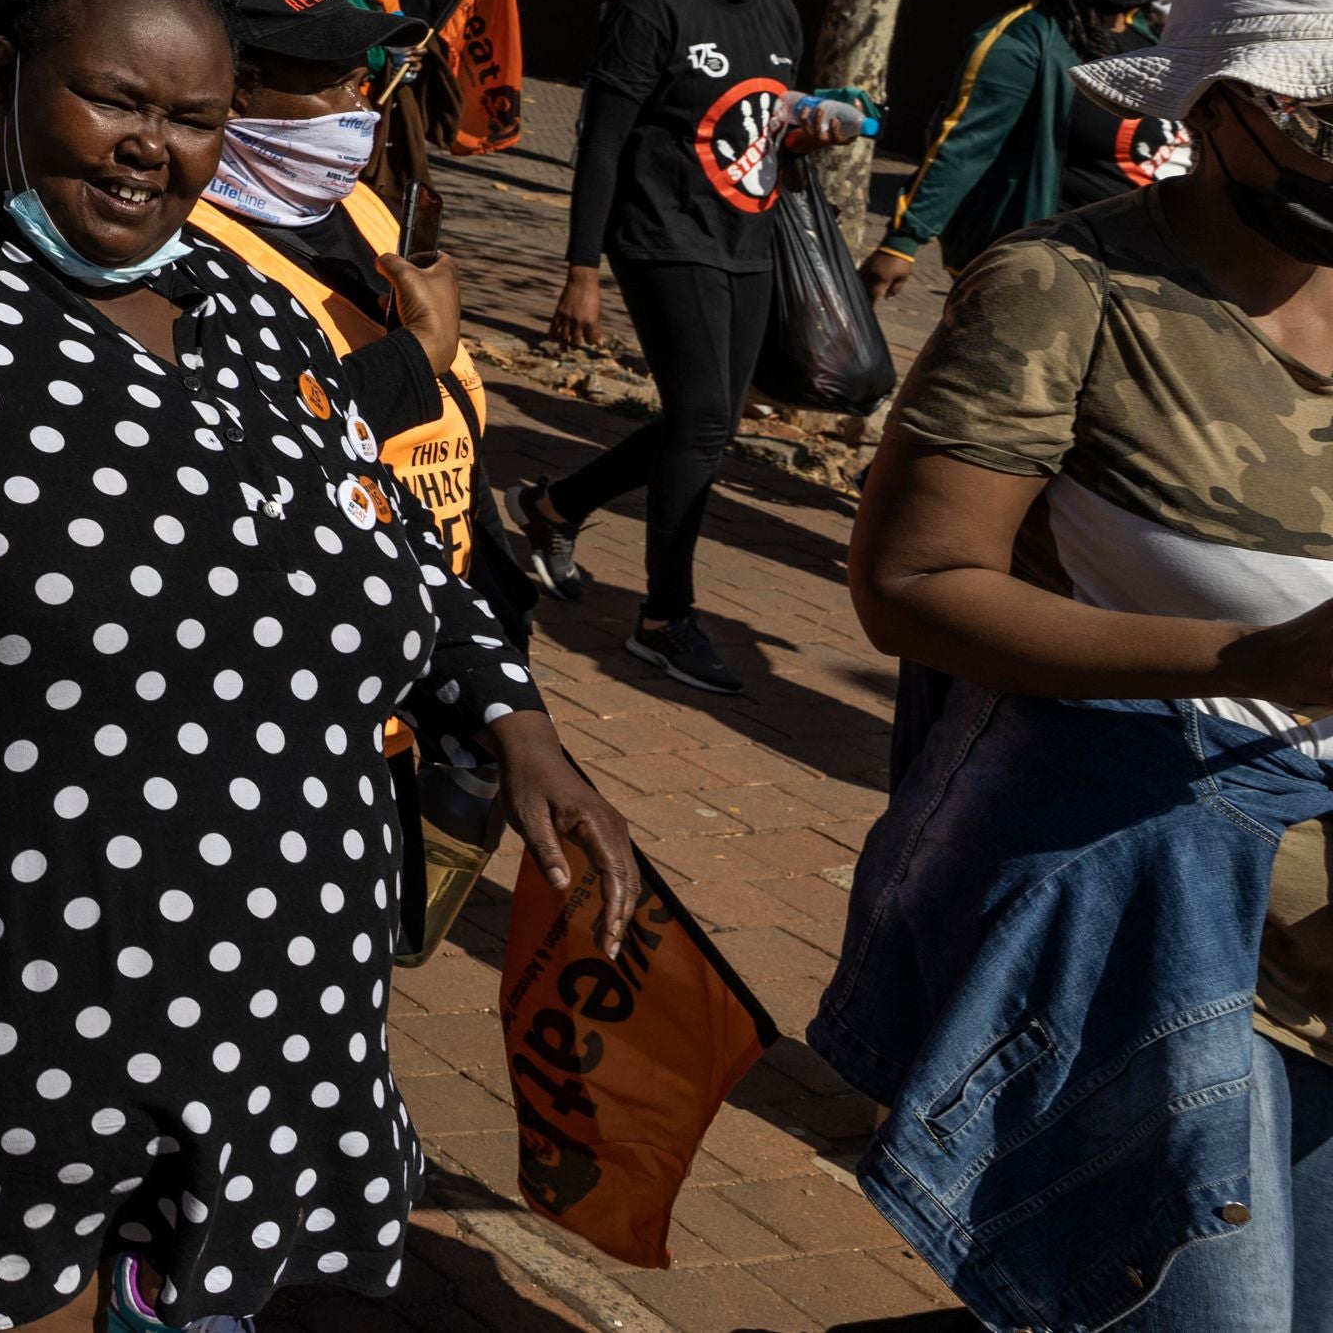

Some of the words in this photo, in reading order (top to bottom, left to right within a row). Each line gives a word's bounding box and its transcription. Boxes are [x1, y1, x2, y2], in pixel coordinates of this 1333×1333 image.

[209, 177, 267, 210] LifeLine
[411, 440, 450, 467] THIS
[455, 436, 470, 459] IS
